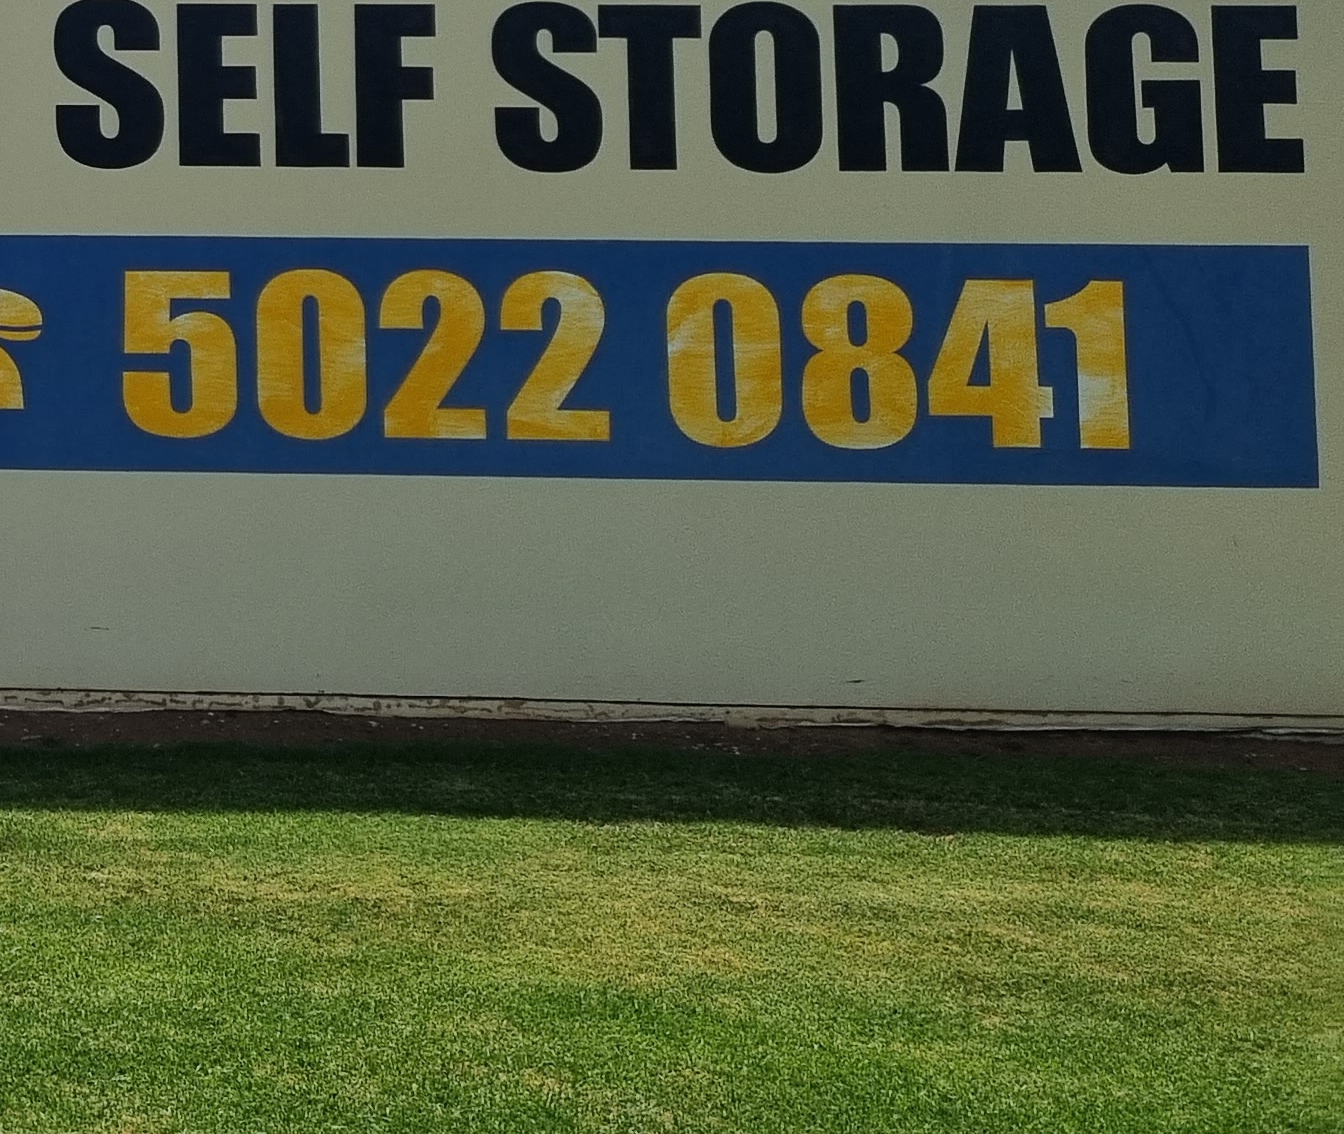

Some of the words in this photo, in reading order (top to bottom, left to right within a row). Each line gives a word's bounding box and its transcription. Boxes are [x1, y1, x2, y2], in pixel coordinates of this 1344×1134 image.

[492, 1, 1304, 174] STORAGE
[122, 270, 610, 441] 5022
[667, 272, 1130, 449] 0841
